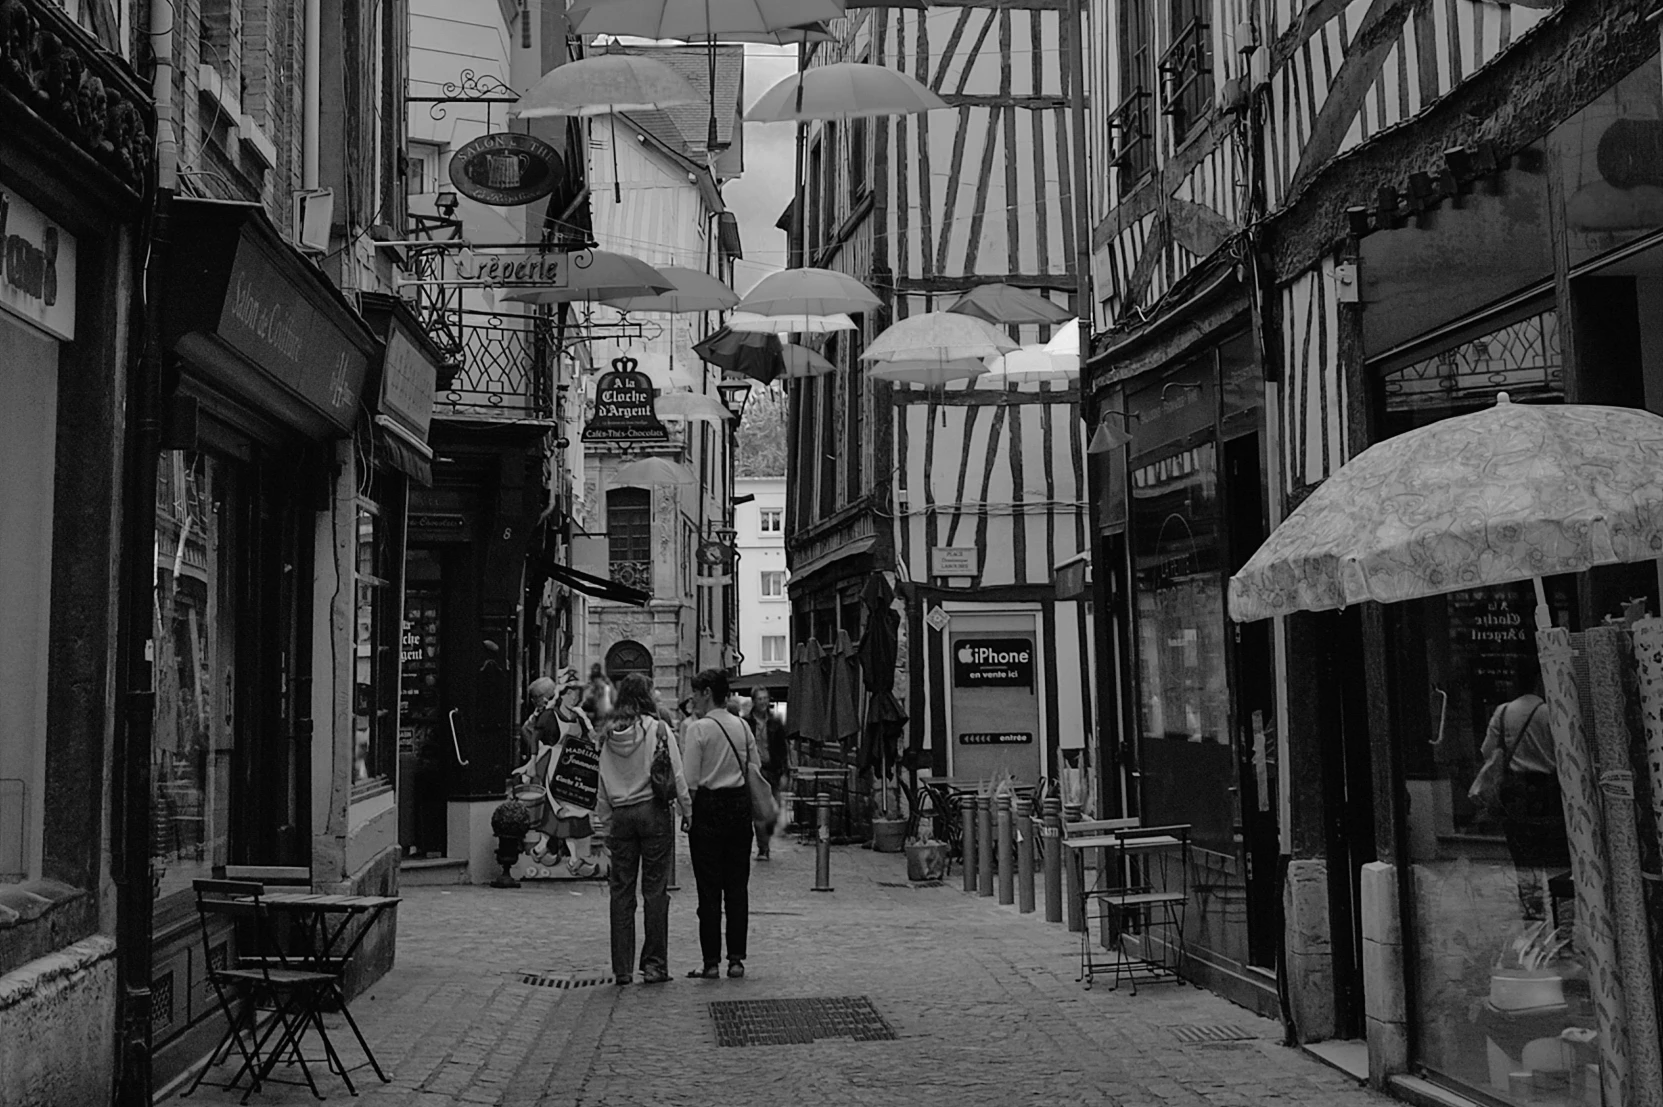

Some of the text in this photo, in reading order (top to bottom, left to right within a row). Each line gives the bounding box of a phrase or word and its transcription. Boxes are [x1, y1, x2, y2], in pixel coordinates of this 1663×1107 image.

[457, 136, 505, 162] SALON
[456, 254, 558, 286] Crêperie
[232, 271, 259, 330] Salon
[268, 303, 302, 363] Coiffure
[613, 377, 636, 388] A la
[601, 390, 648, 404] Cloche
[598, 404, 651, 418] d'Argent
[503, 527, 512, 540] 8
[403, 632, 420, 649] che
[401, 649, 423, 662] gent
[974, 647, 1030, 664] iPhone
[982, 670, 1007, 679] vente
[1007, 670, 1019, 678] ici
[565, 746, 600, 761] MADELEIN
